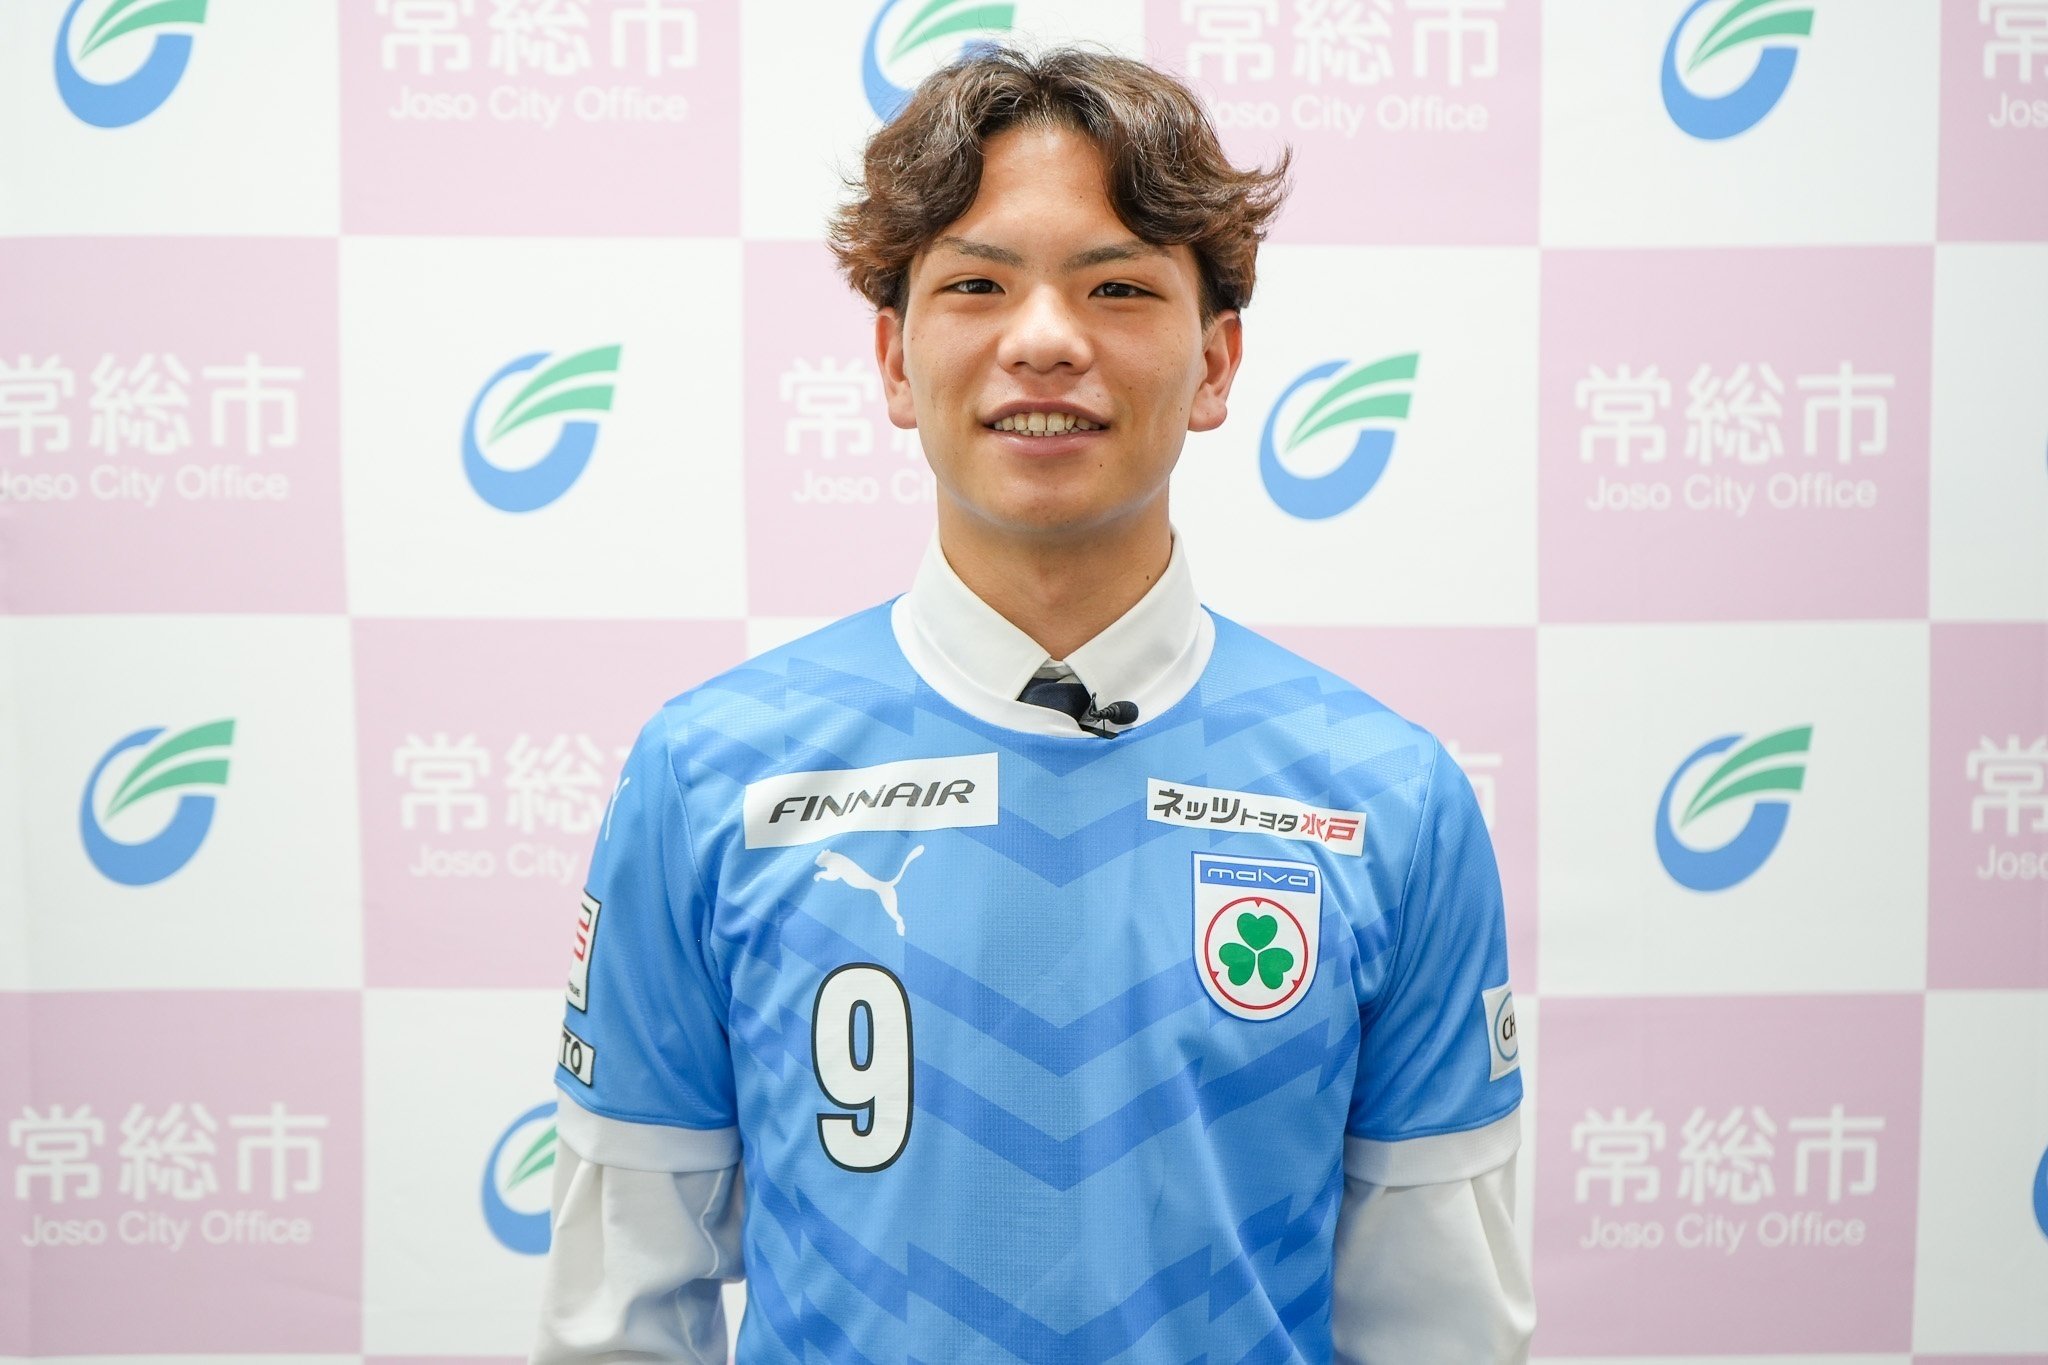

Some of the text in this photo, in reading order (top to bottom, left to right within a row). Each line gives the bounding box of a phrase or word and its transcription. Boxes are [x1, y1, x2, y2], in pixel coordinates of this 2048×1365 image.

[1179, 0, 1505, 86] 常総市
[387, 84, 690, 130] Joso City Office
[1206, 94, 1489, 138] oso City Office
[0, 351, 305, 457] 常総市
[780, 354, 923, 461] 常
[1574, 359, 1896, 468] 常総市
[89, 463, 166, 508] City
[175, 463, 290, 501] Office
[790, 469, 880, 504] Joso
[1585, 472, 1878, 519] Joso City Office
[392, 731, 632, 834] 常総
[768, 779, 976, 824] FINNAIR
[1153, 788, 1360, 843] ネッツトヨタ水戸
[407, 842, 579, 886] Joso City
[1207, 867, 1310, 887] malva
[811, 961, 914, 1174] 9
[9, 1101, 329, 1203] 常総市
[1571, 1104, 1886, 1207] 常総市
[20, 1210, 314, 1253] Joso City Office
[1580, 1211, 1866, 1256] Joso City Office
